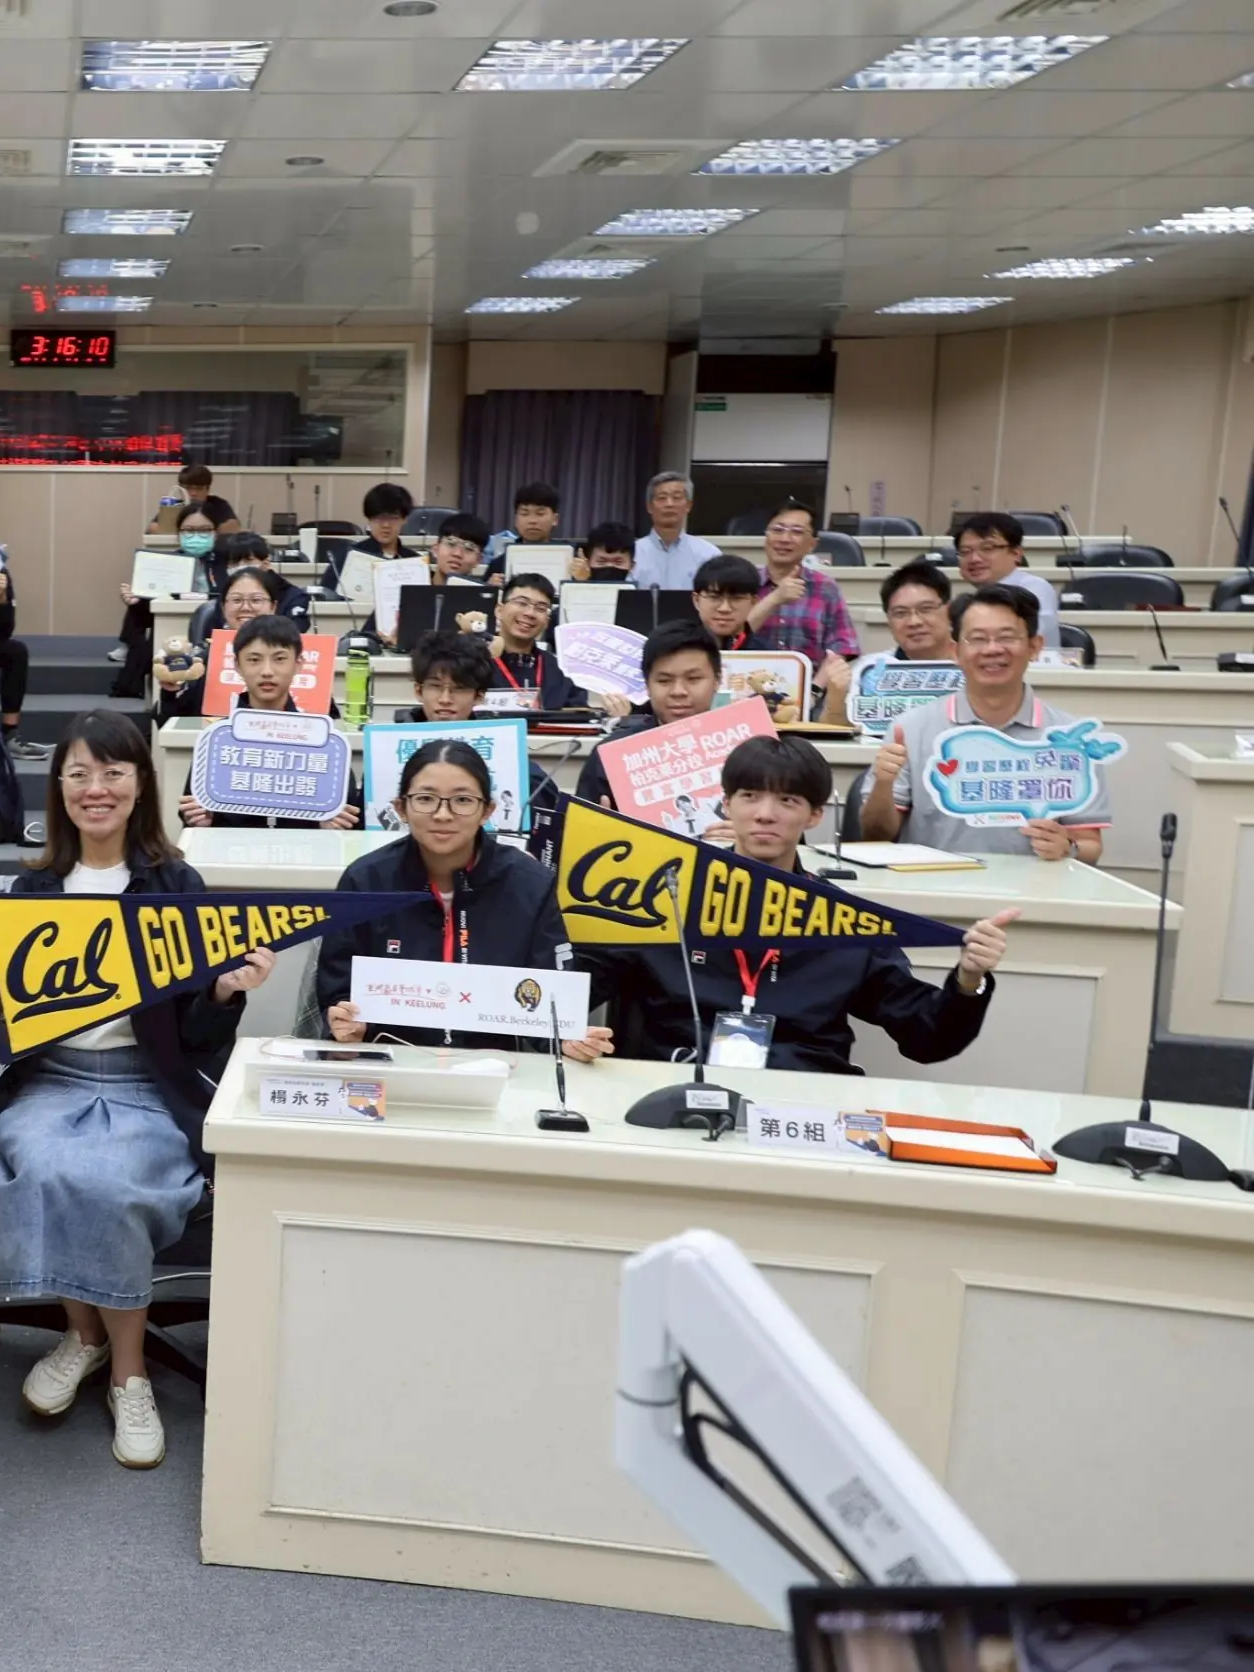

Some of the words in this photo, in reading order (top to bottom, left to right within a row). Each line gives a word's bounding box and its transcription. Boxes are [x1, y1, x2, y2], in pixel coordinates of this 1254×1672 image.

[699, 722, 753, 752] ROAR
[219, 744, 330, 775] 教育新力量
[621, 732, 697, 772] 加州大學
[229, 770, 318, 798] 基隆出發
[959, 777, 1073, 803] 基隆罩你
[560, 838, 683, 930] Cal
[699, 858, 752, 937] GO
[5, 916, 121, 1012] Cal
[137, 905, 194, 990] GO
[390, 997, 401, 1007] IN
[404, 999, 447, 1010] KEELUNG
[269, 1089, 330, 1107] 楊永芬
[759, 1117, 827, 1143] 第6組
